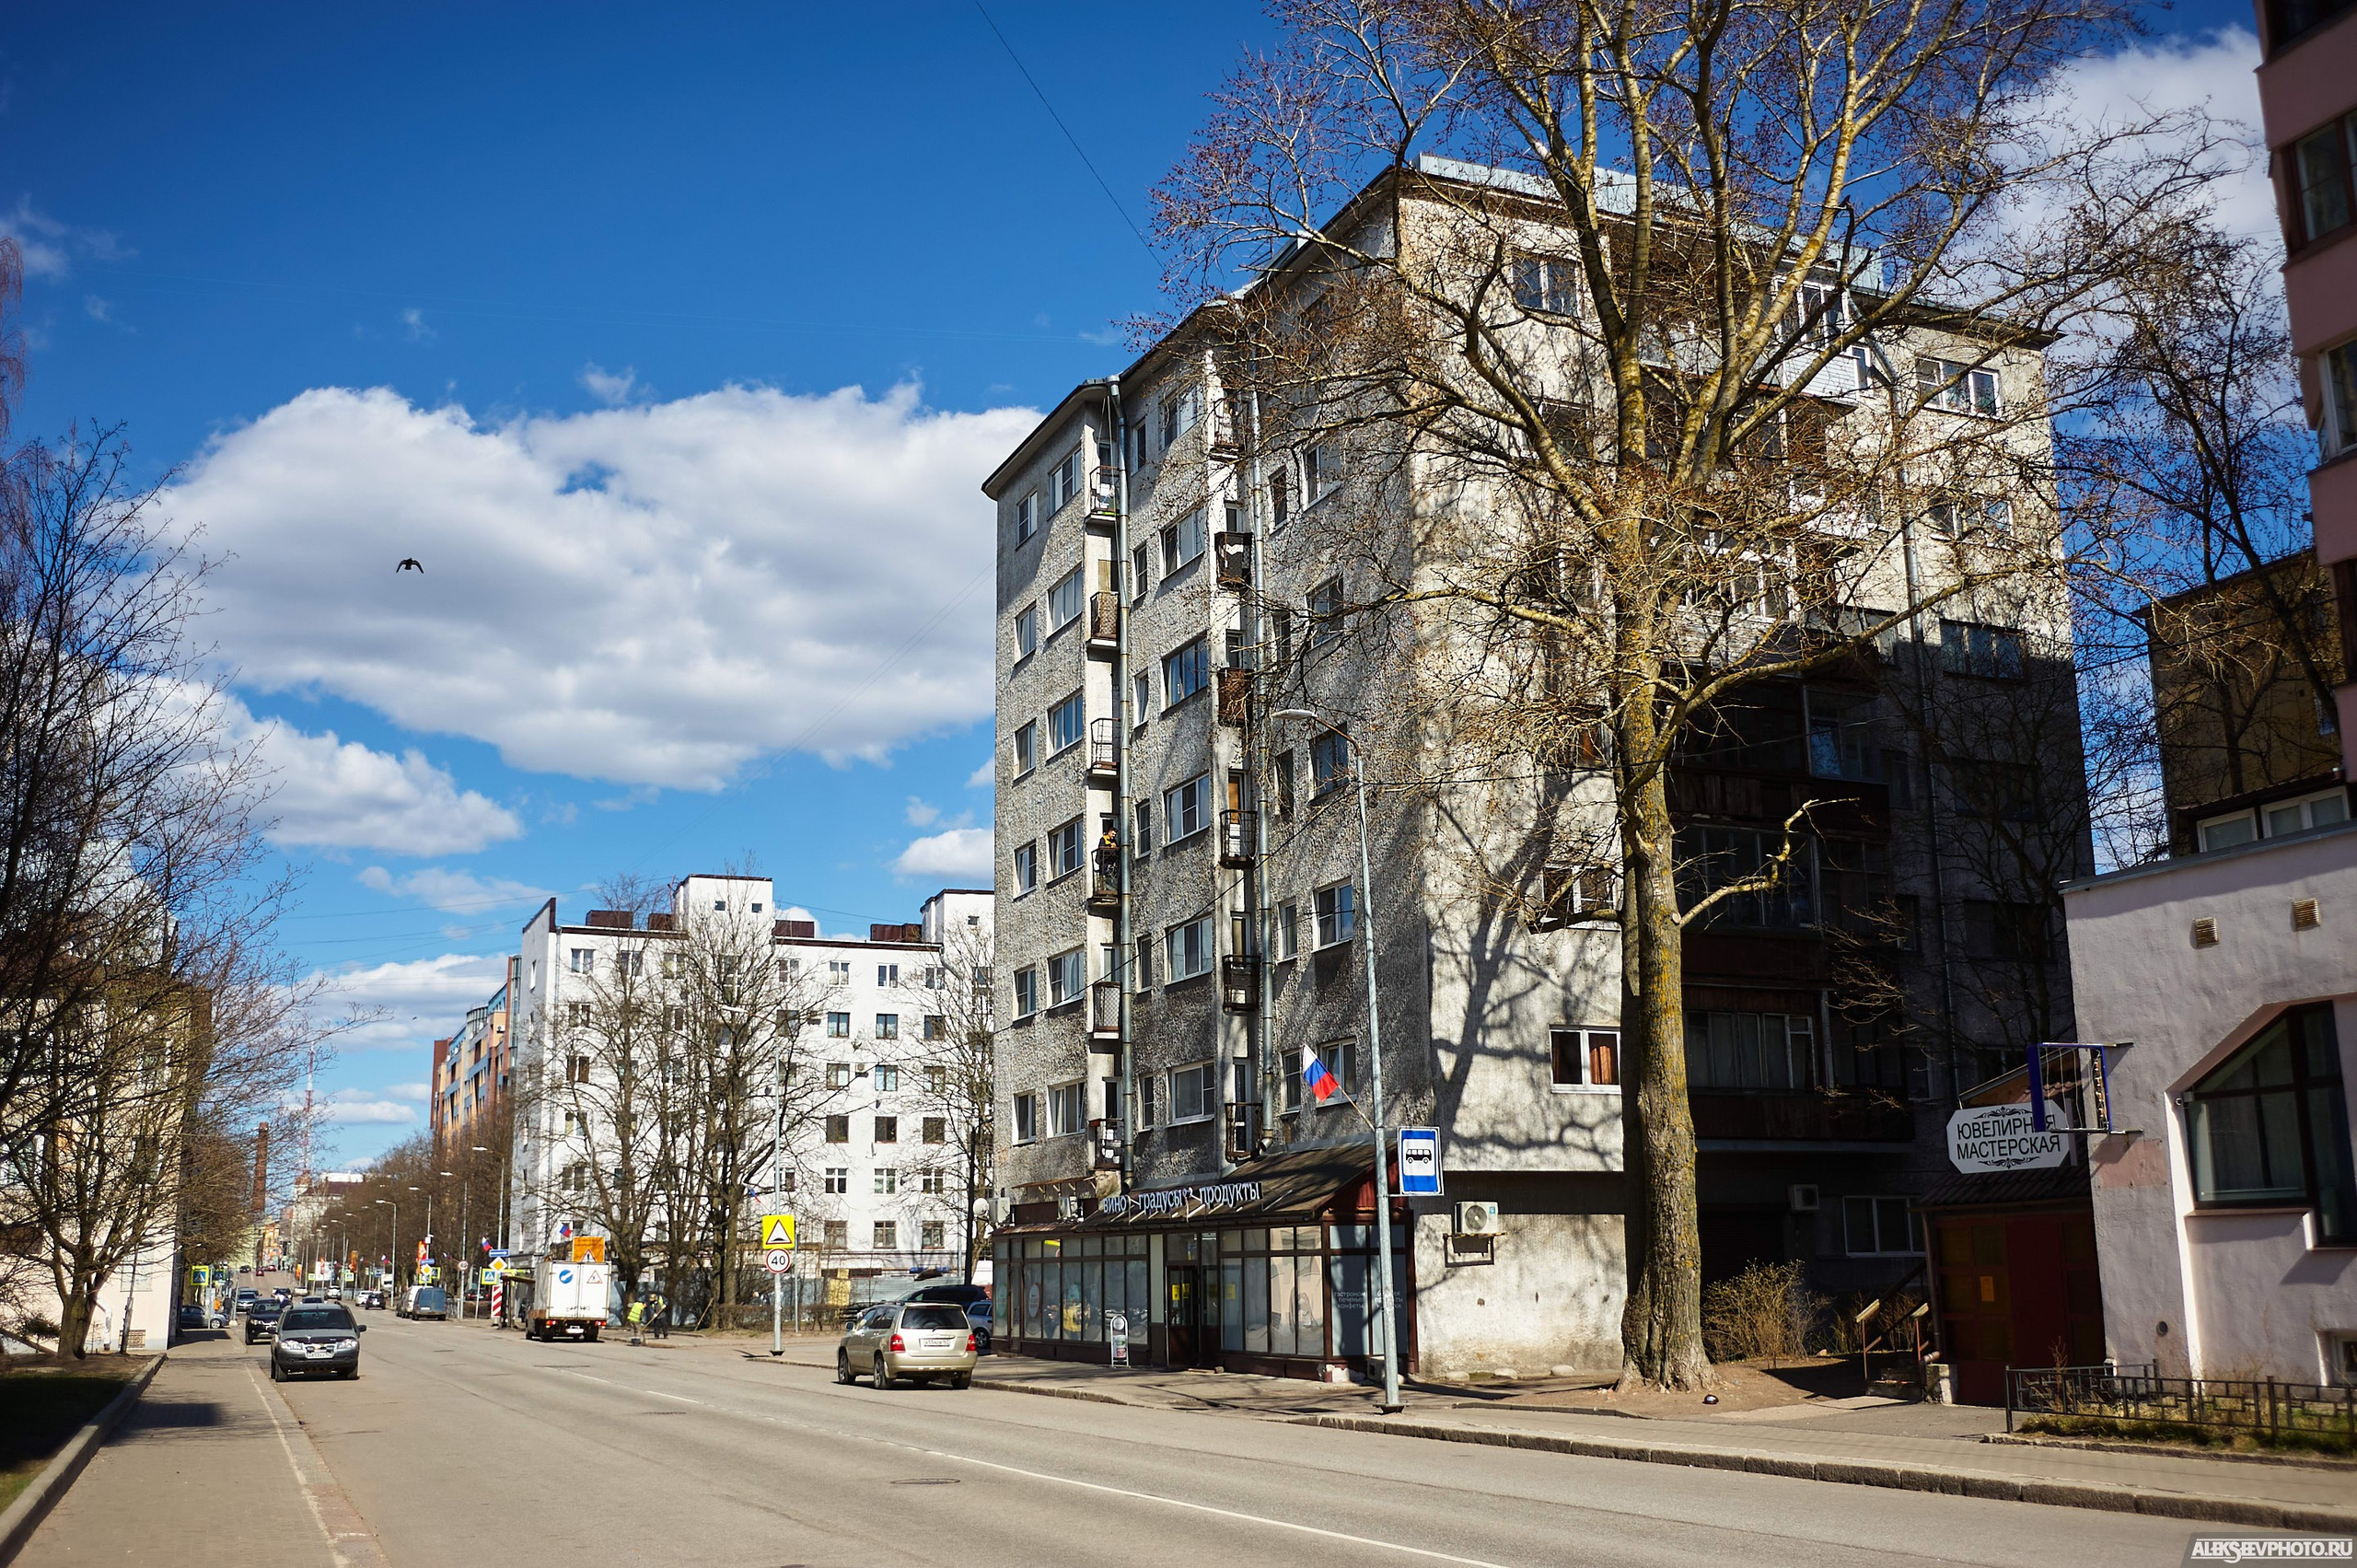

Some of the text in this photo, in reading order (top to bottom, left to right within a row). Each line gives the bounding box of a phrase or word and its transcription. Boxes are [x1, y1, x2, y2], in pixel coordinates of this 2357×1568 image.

[1957, 1114, 2055, 1140] ЮВЕЛИРНЯ
[1956, 1134, 2061, 1159] МАСТЕРСКАЯ
[1104, 1195, 1127, 1214] вино
[1199, 1182, 1260, 1209] продукты
[772, 1255, 785, 1265] 40
